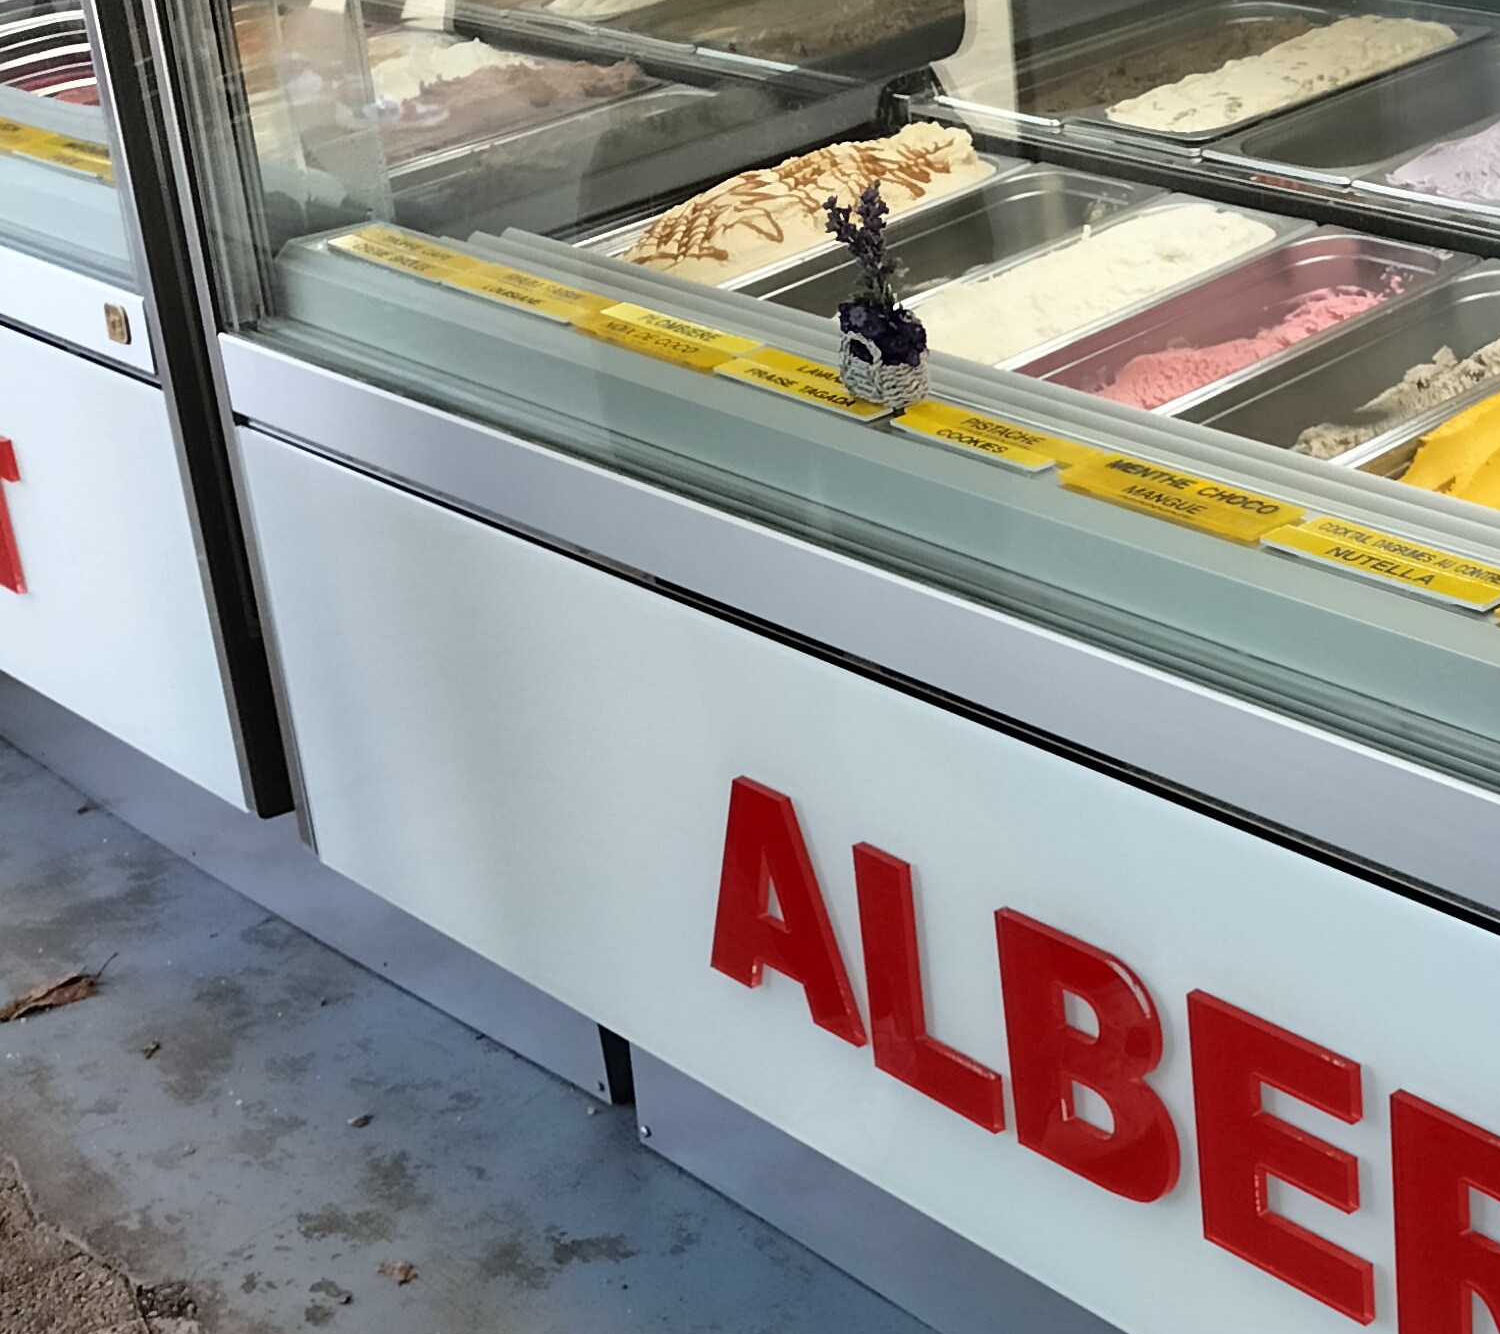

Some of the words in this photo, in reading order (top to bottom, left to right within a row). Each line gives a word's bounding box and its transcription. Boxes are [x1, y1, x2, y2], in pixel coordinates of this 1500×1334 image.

[654, 334, 700, 354] COCO
[744, 367, 798, 388] FRAISE
[797, 384, 857, 407] TAGADA
[936, 428, 1009, 455] COOKIES
[960, 416, 1046, 446] PISTACHE
[1105, 457, 1197, 490] MENTHE
[1197, 485, 1281, 516] CHOCO
[1122, 485, 1208, 516] MANGUE
[1318, 522, 1373, 544] COCKTAIL
[1432, 557, 1453, 569] AU
[1324, 546, 1436, 585] NUTELLA
